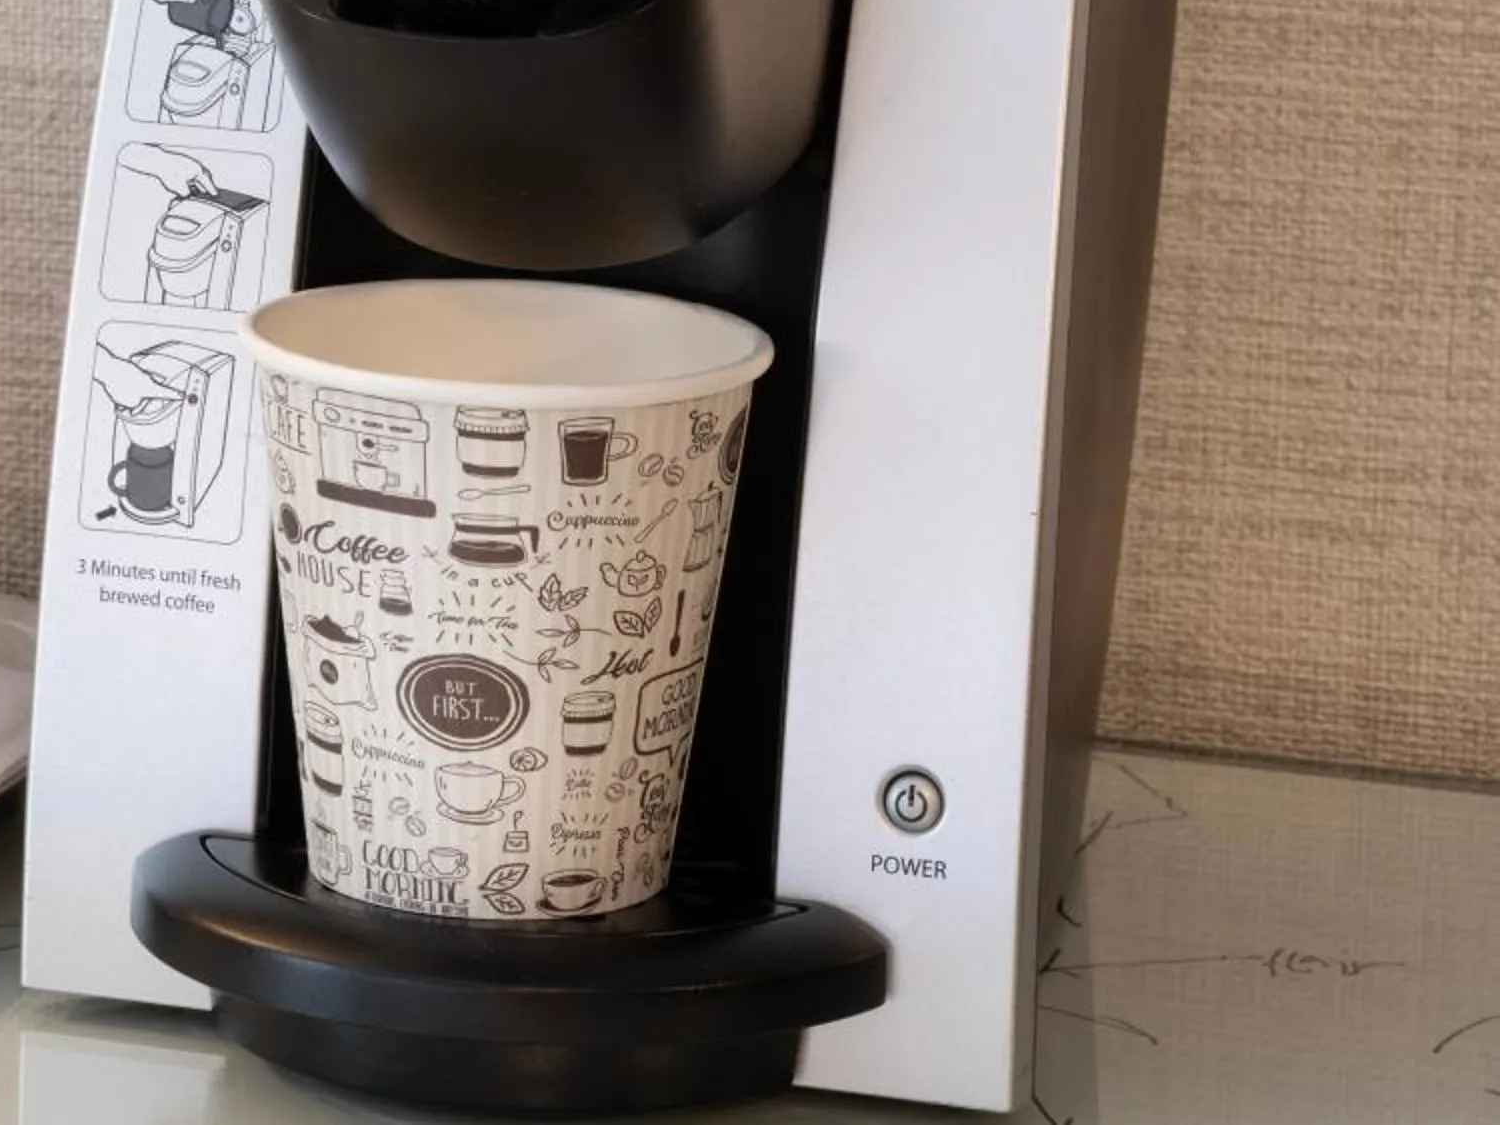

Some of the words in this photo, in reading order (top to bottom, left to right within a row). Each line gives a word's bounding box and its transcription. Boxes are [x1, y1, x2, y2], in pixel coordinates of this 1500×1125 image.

[547, 510, 640, 531] Cappuccino
[303, 520, 410, 564] Coffee
[76, 558, 87, 574] 3
[91, 559, 155, 581] Minutes
[159, 568, 197, 586] until
[200, 570, 241, 592] fresh
[297, 551, 372, 598] HOUSE
[100, 586, 160, 607] brewed
[165, 592, 216, 613] coffee
[445, 679, 478, 695] BUT
[363, 839, 420, 873] GOOD
[871, 854, 947, 879] POWER
